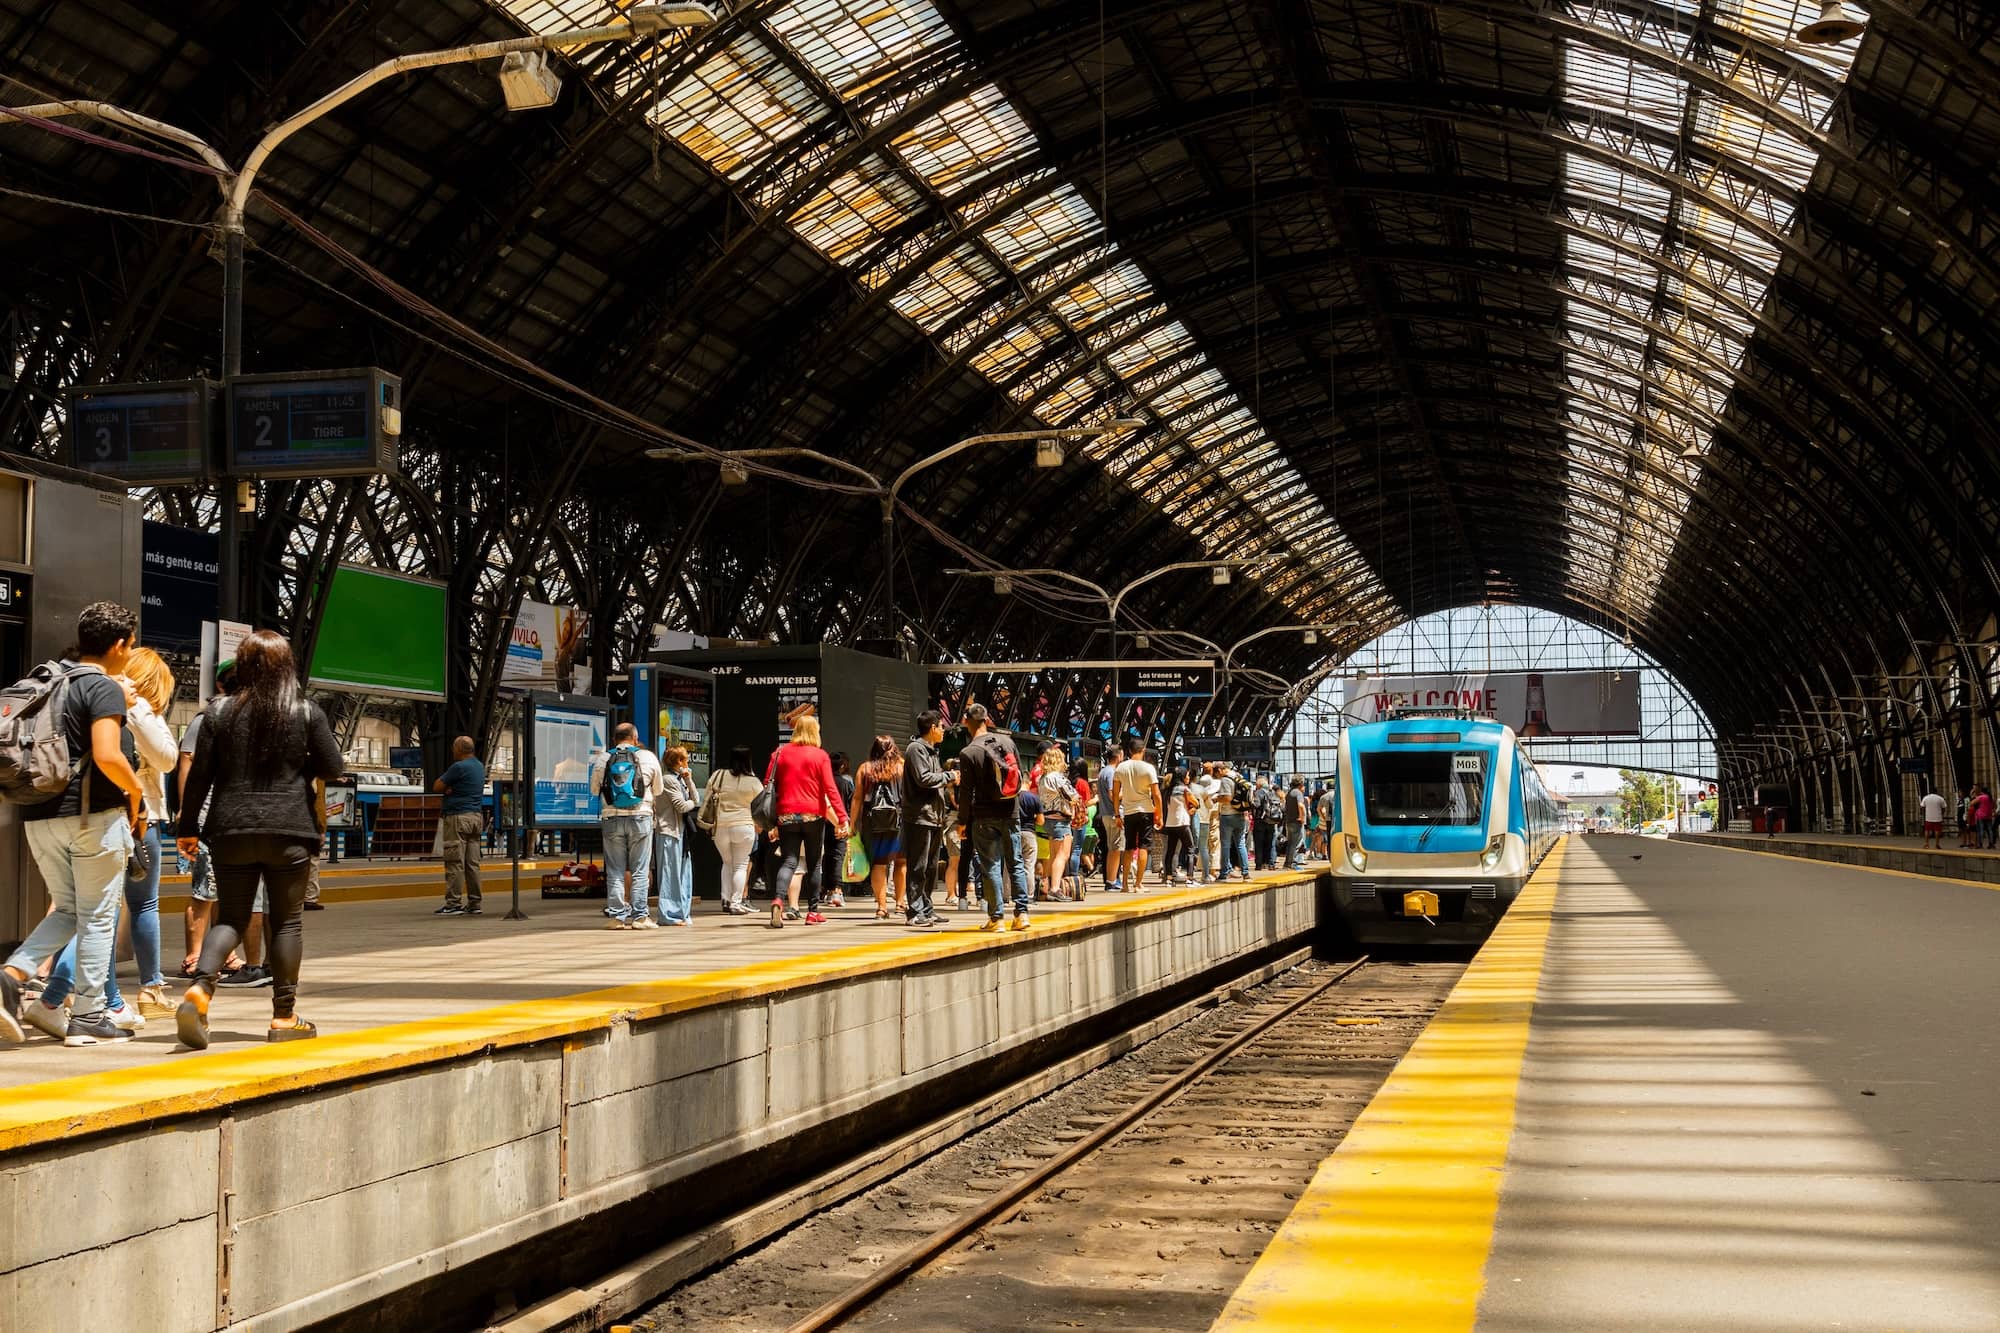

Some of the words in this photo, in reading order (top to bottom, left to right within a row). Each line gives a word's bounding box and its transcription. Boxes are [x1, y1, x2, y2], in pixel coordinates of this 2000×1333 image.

[255, 415, 273, 446] 2
[312, 426, 345, 438] TIGRE
[95, 427, 112, 458] 3
[145, 552, 165, 563] más
[166, 556, 193, 569] gente
[193, 561, 204, 571] se
[745, 676, 817, 685] SANDWICHES
[1456, 760, 1478, 769] M08
